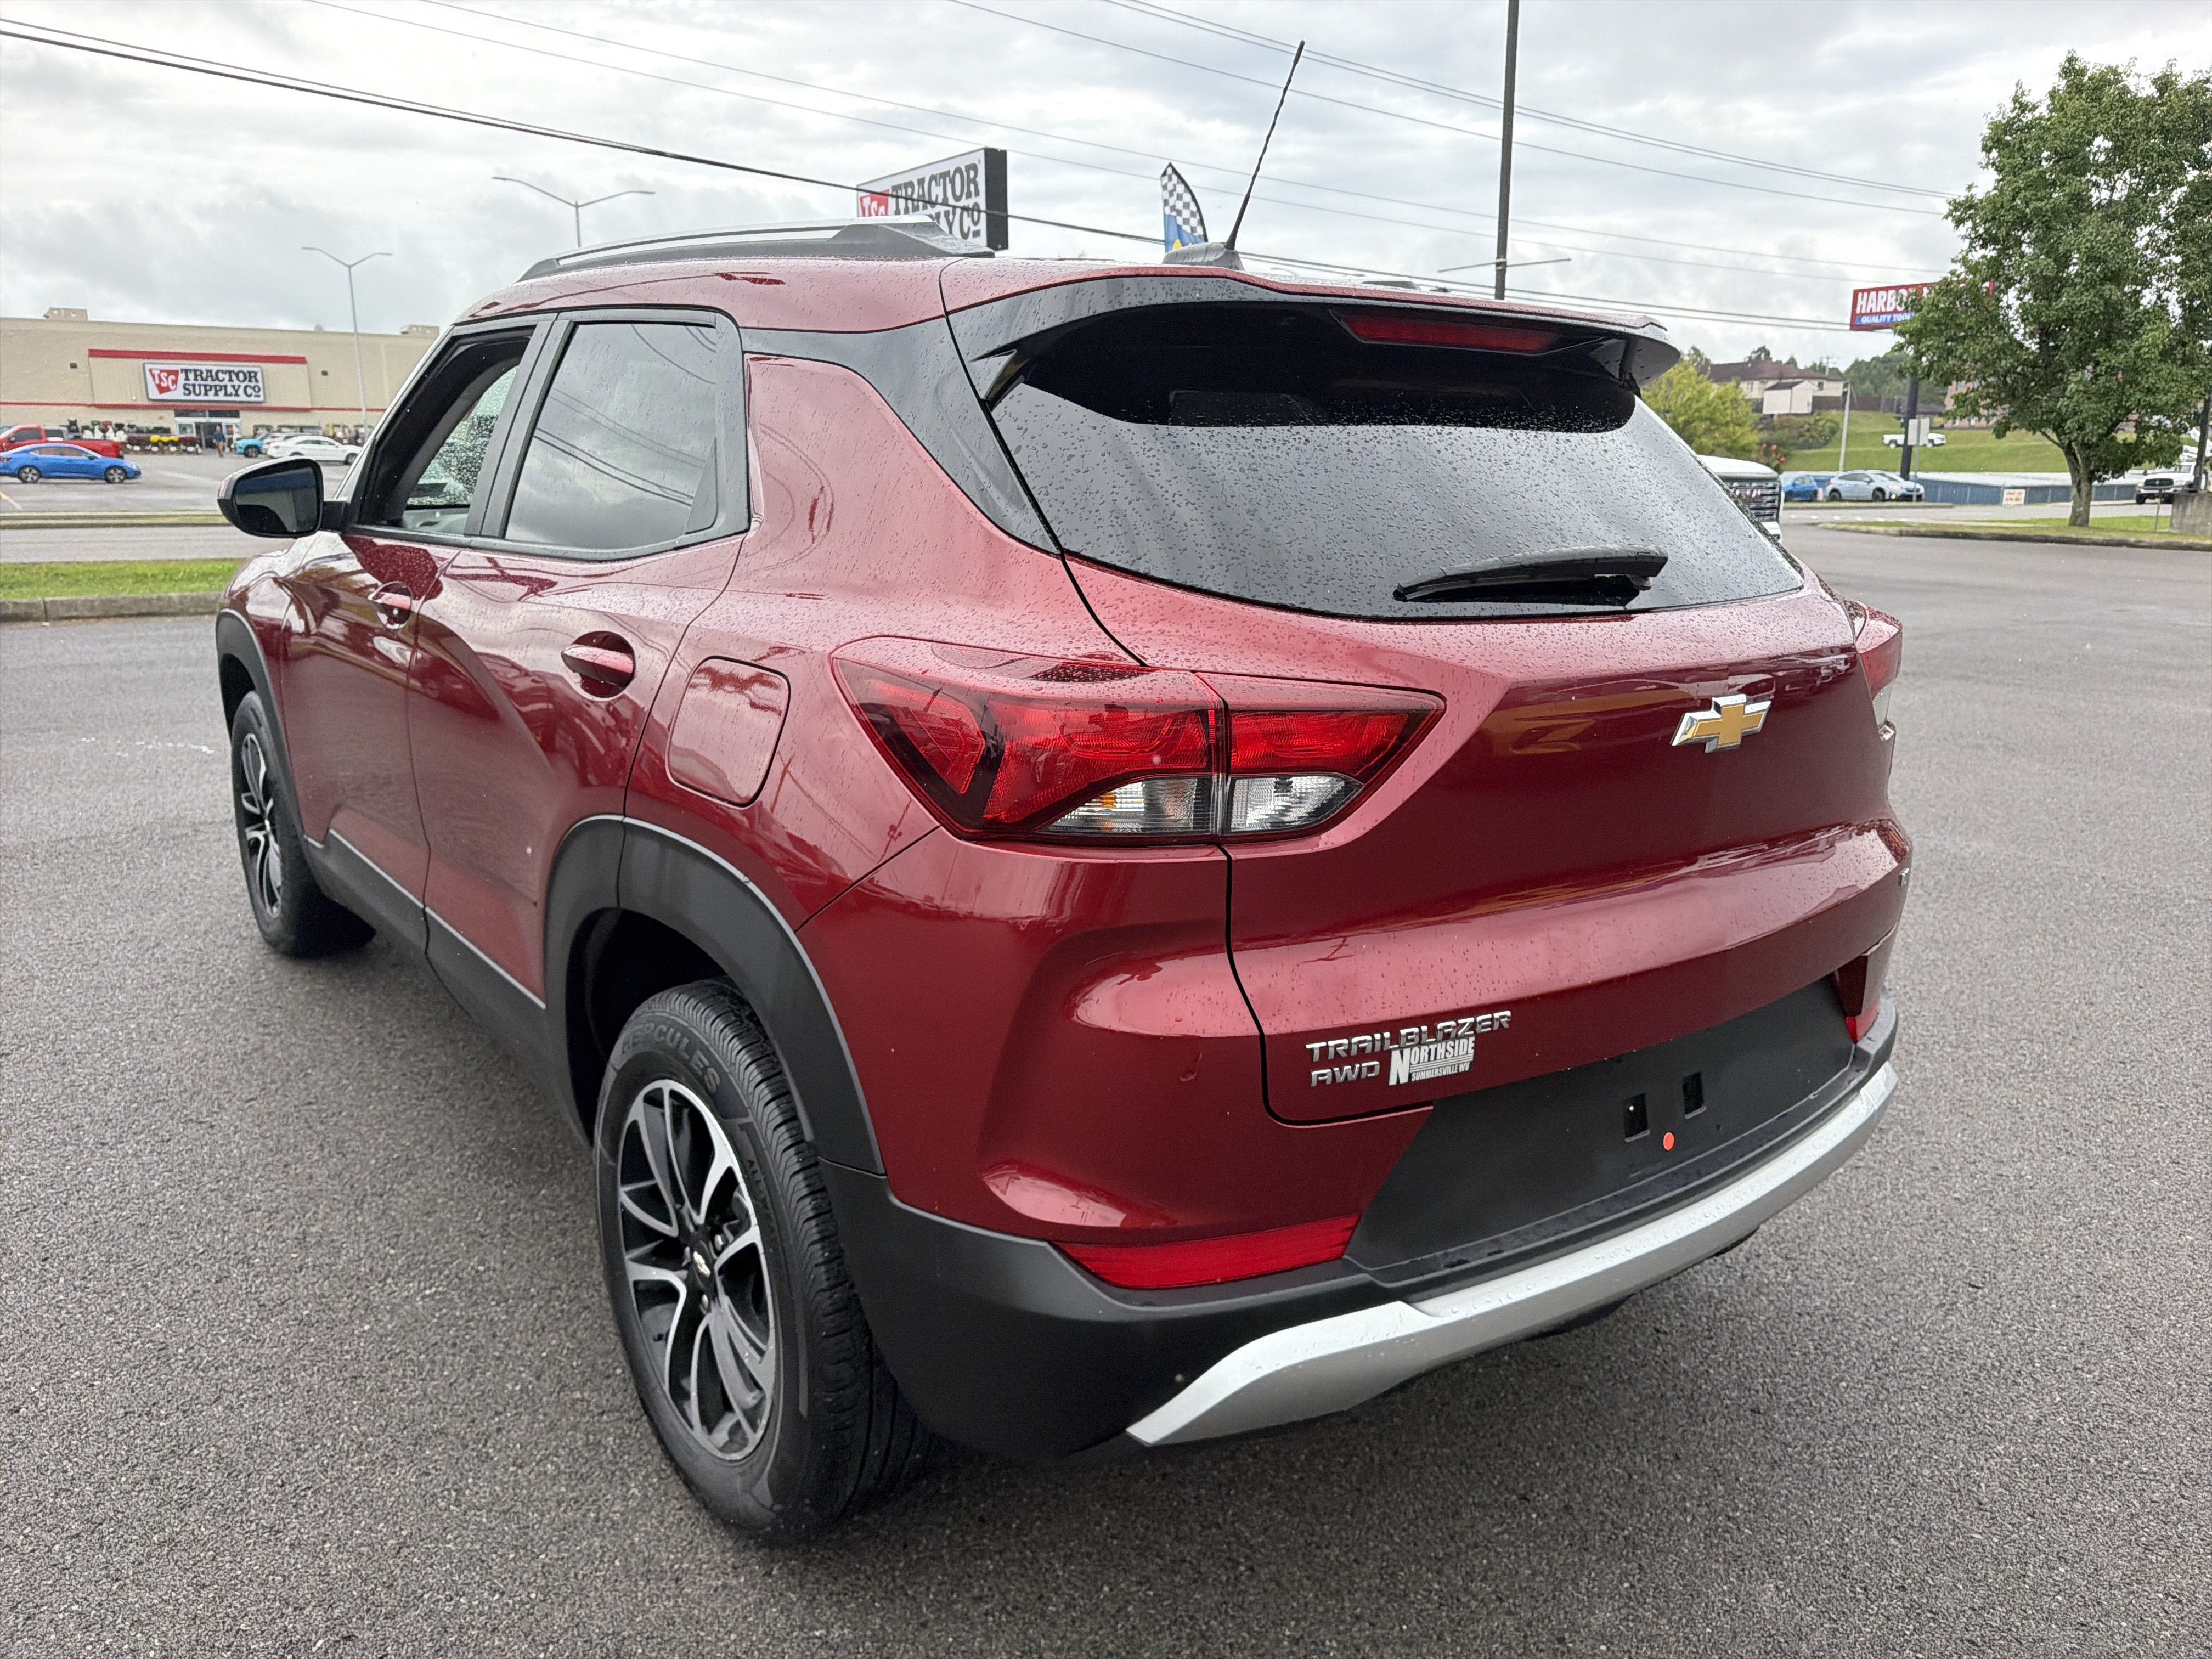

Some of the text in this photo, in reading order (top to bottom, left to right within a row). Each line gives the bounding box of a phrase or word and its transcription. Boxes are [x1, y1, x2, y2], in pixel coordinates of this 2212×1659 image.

[891, 163, 980, 216] TRACTOR
[152, 370, 176, 390] TSC
[180, 368, 259, 383] TRACTOR
[183, 383, 240, 397] SUPPLY
[1306, 1011, 1512, 1062] TRAILBLAZER
[1389, 1036, 1475, 1086] NORTHSIDE
[1411, 1062, 1470, 1082] SUMMERSVILLE WV
[1310, 1060, 1380, 1087] AWD
